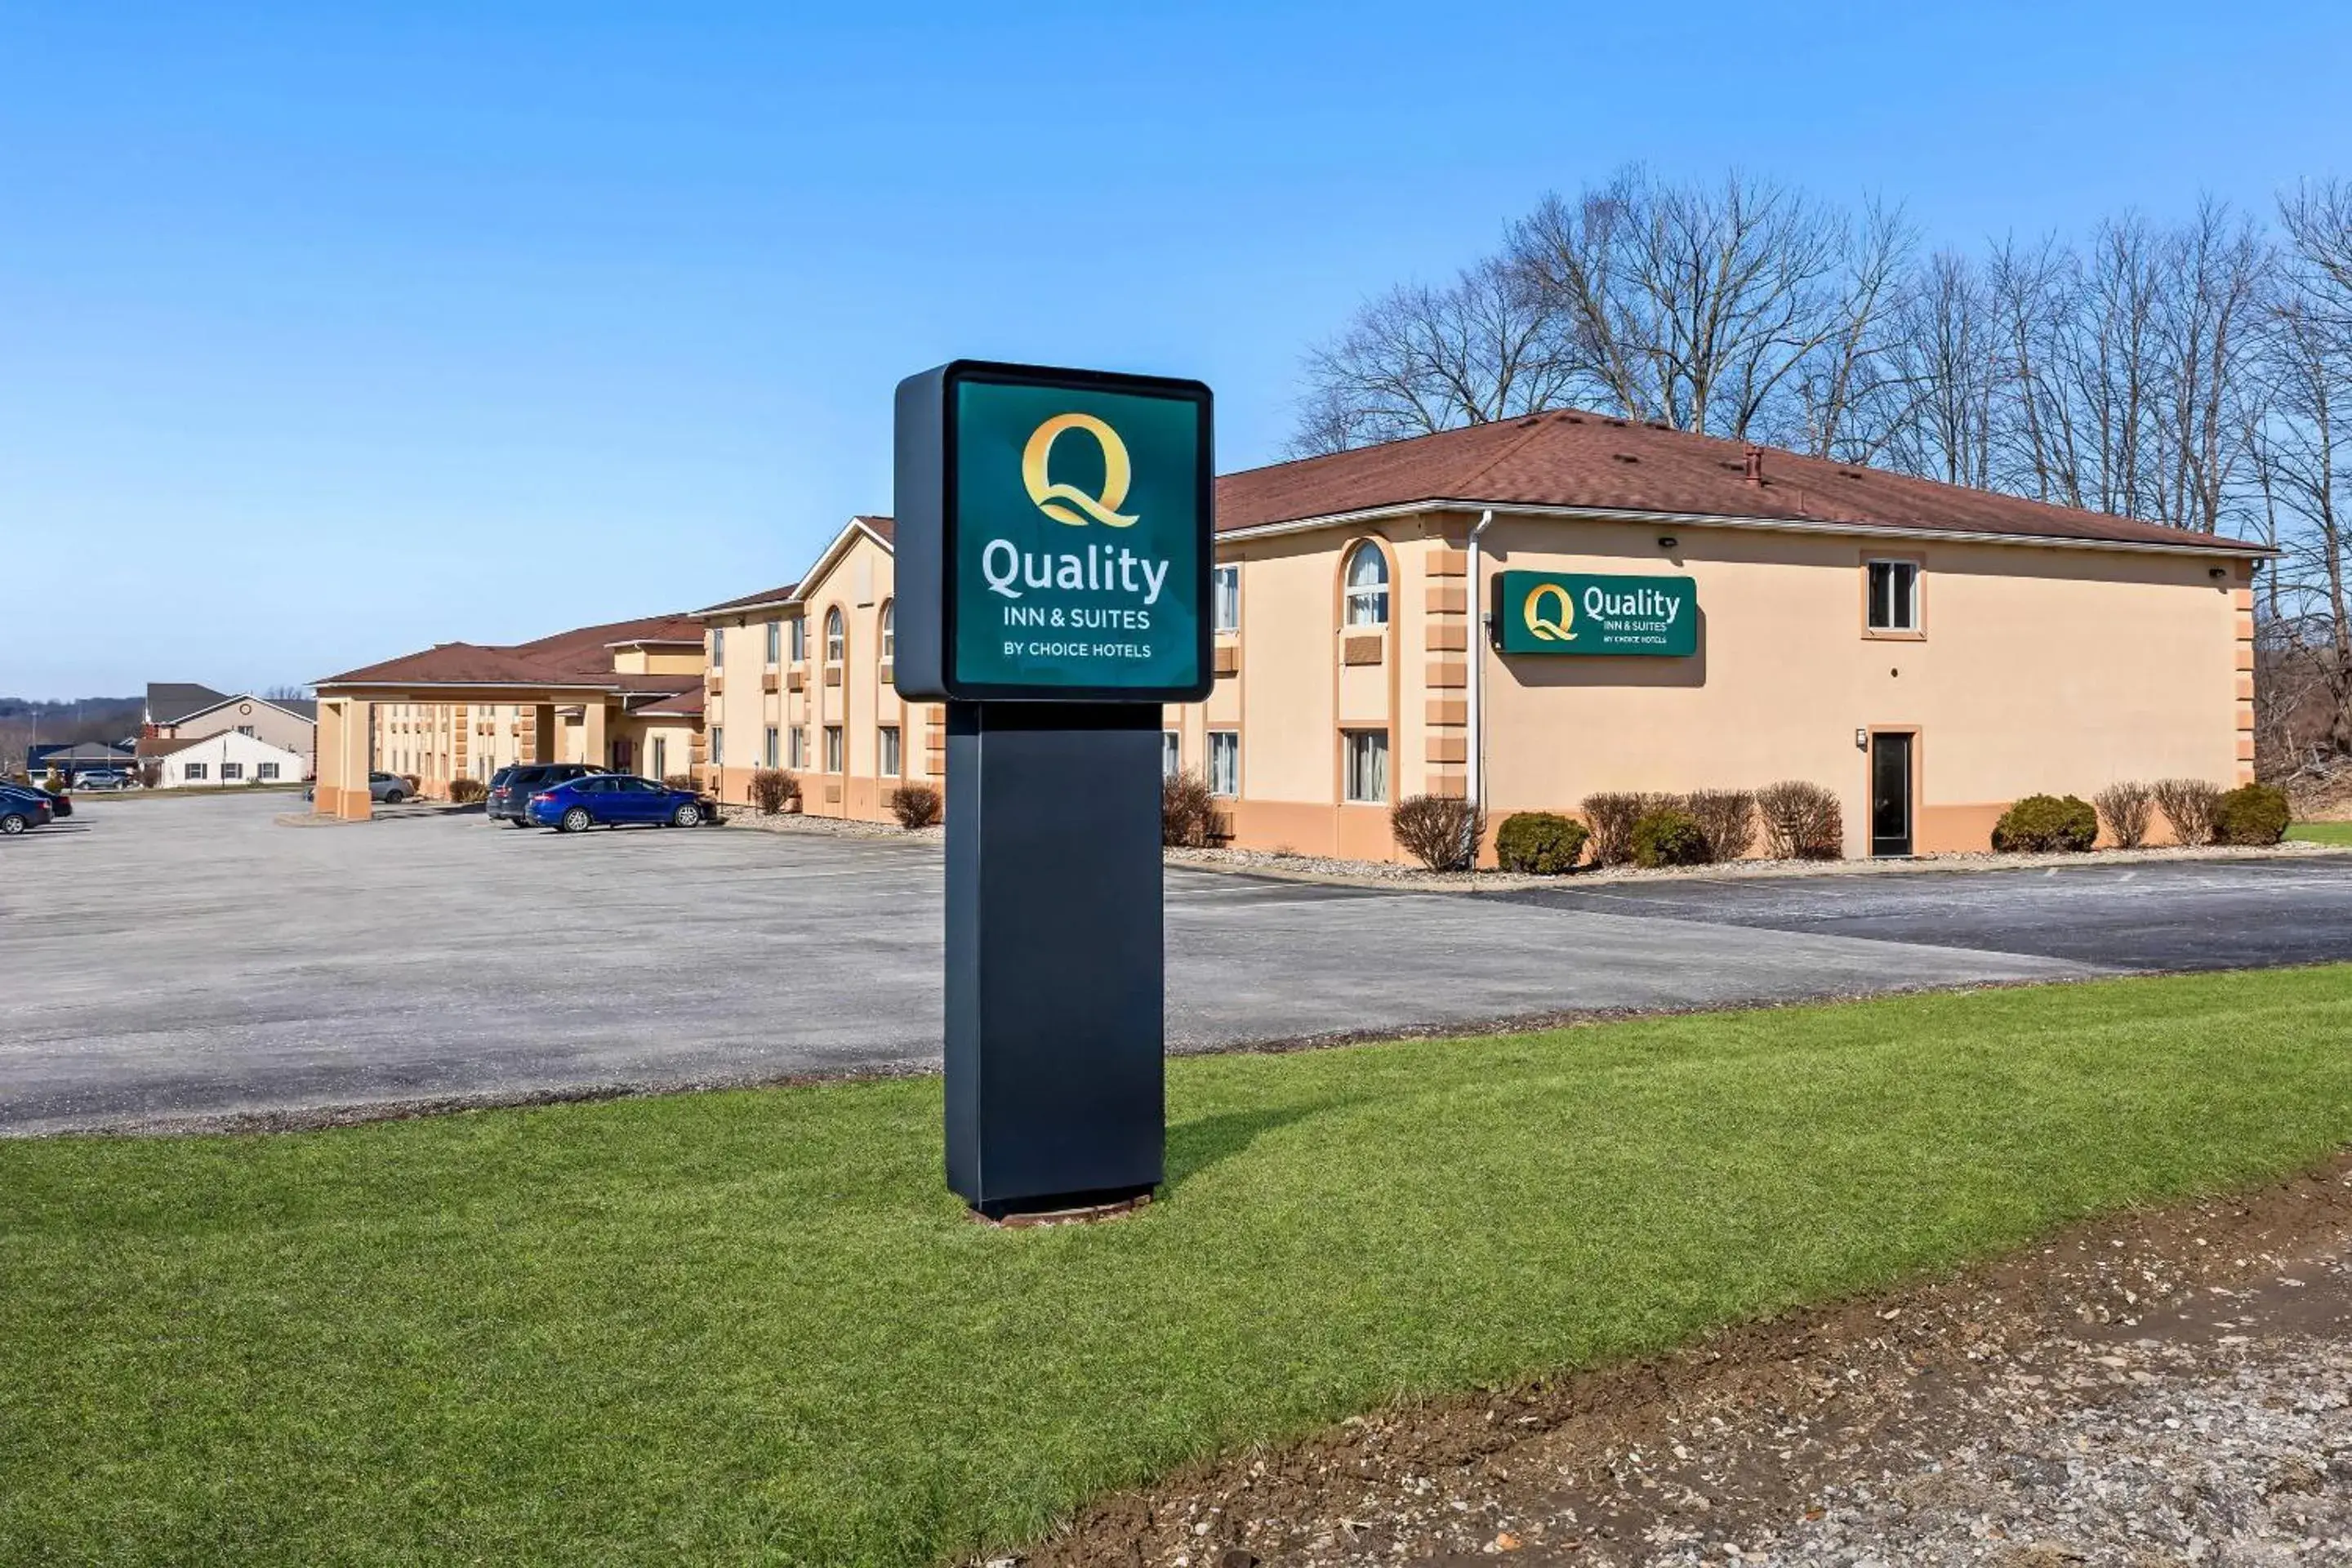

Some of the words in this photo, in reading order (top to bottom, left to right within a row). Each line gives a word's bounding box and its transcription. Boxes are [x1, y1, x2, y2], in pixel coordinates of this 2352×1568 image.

[982, 539, 1169, 604] Quality
[1584, 586, 1680, 623] Quality
[1004, 607, 1045, 627] INN
[1050, 608, 1066, 627] &
[1071, 608, 1150, 630] SUITES
[1603, 621, 1622, 630] INN
[1624, 621, 1631, 631] &
[1632, 621, 1667, 631] SUITES
[1004, 642, 1025, 656] BY
[1029, 642, 1088, 657] CHOICE
[1094, 644, 1152, 658] HOTELS
